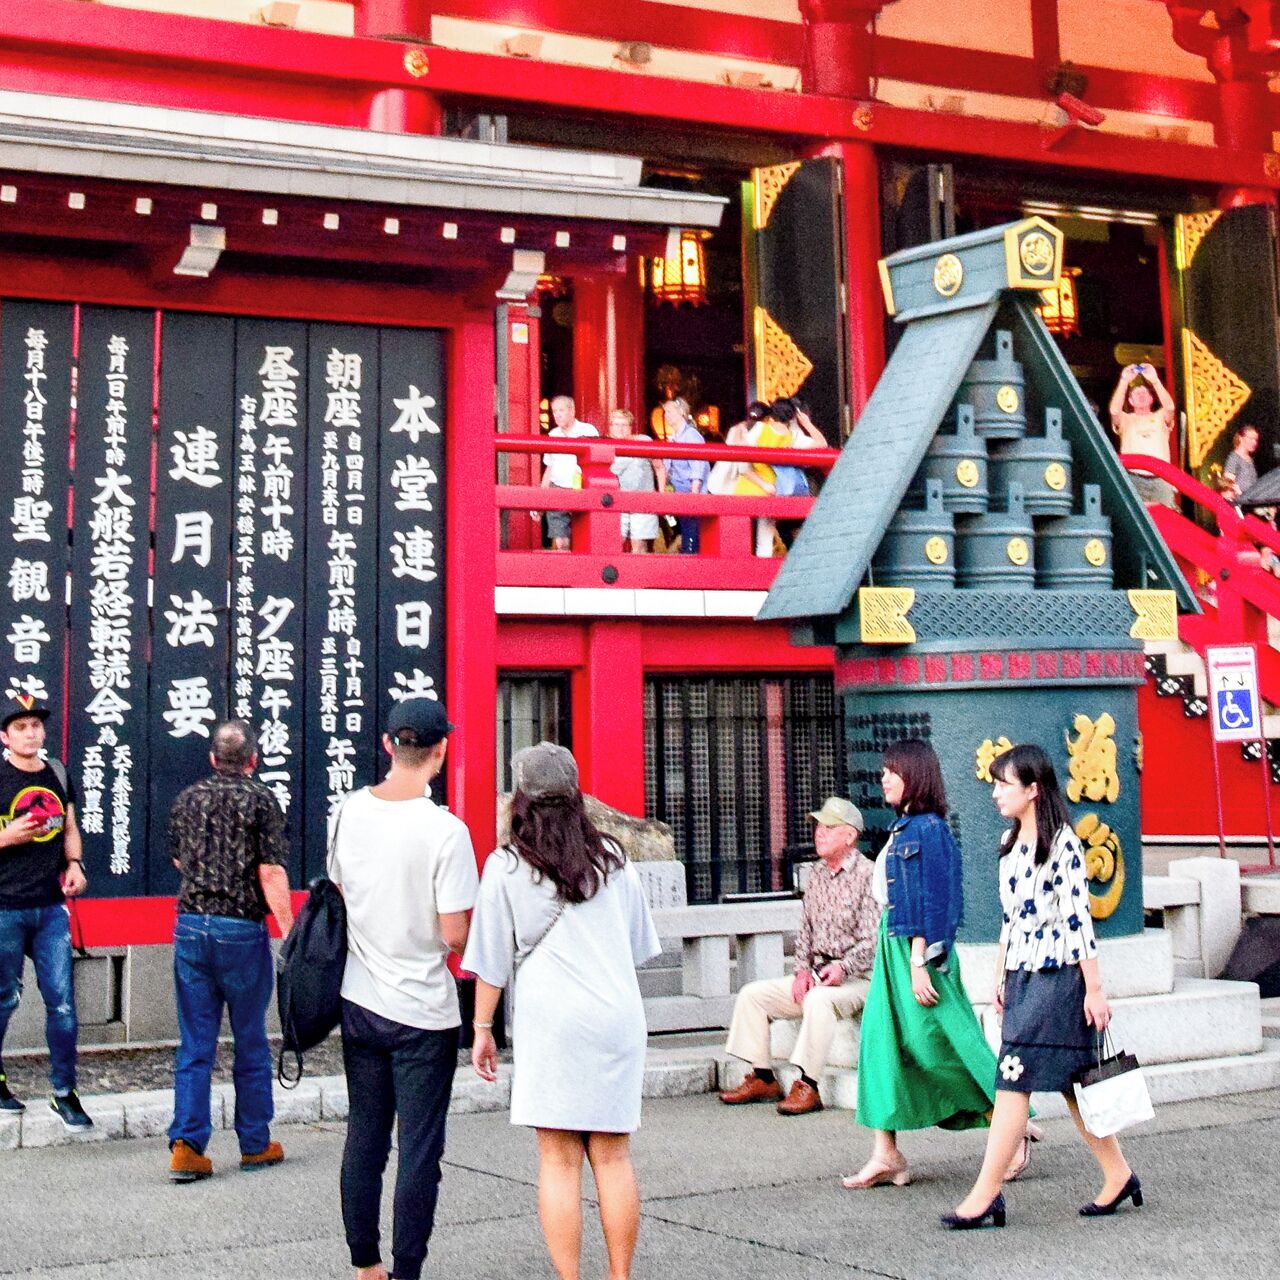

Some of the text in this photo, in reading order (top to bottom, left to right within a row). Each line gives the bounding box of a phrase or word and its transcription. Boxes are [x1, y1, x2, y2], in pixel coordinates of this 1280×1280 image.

[21, 326, 49, 496] 毎月十八日午後二時
[103, 334, 130, 467] 毎月一日午前十時
[323, 347, 363, 428] 朝座
[321, 431, 340, 526] 至九月末日
[344, 431, 366, 526] 自四月一日
[3, 495, 53, 761] 聖観音法
[84, 467, 137, 726] 大般若経転読会
[162, 425, 223, 739] 連月法要
[327, 529, 358, 636] 午前六時
[387, 384, 441, 801] 本堂連日法
[320, 637, 339, 733] 至三月末日
[343, 637, 365, 733] 自十月一日
